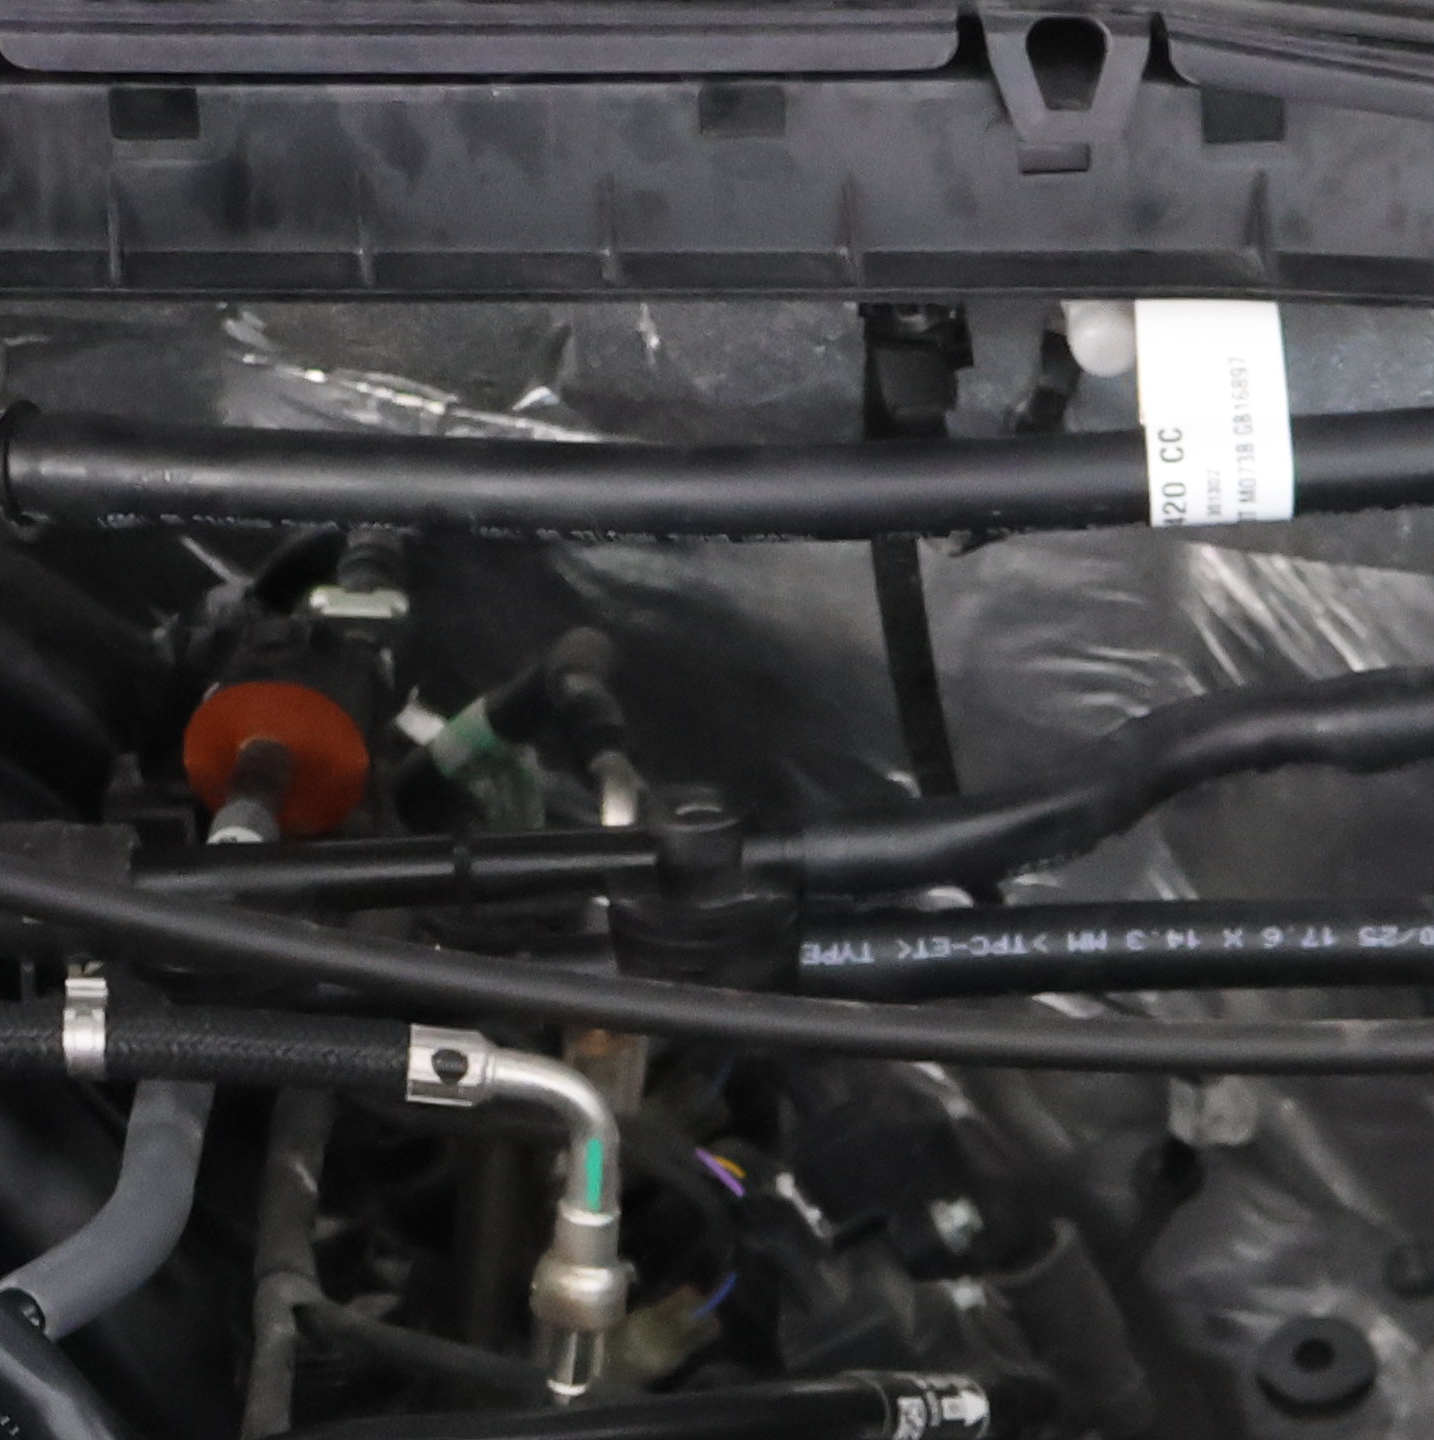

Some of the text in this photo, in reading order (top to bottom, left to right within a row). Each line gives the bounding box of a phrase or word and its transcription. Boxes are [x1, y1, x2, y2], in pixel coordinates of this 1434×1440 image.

[1158, 428, 1184, 463] CC
[1067, 930, 1108, 951] MM
[1125, 929, 1200, 951] 14.3
[1224, 928, 1244, 948] X
[1263, 926, 1336, 949] 17.6
[800, 941, 874, 966] TYPE
